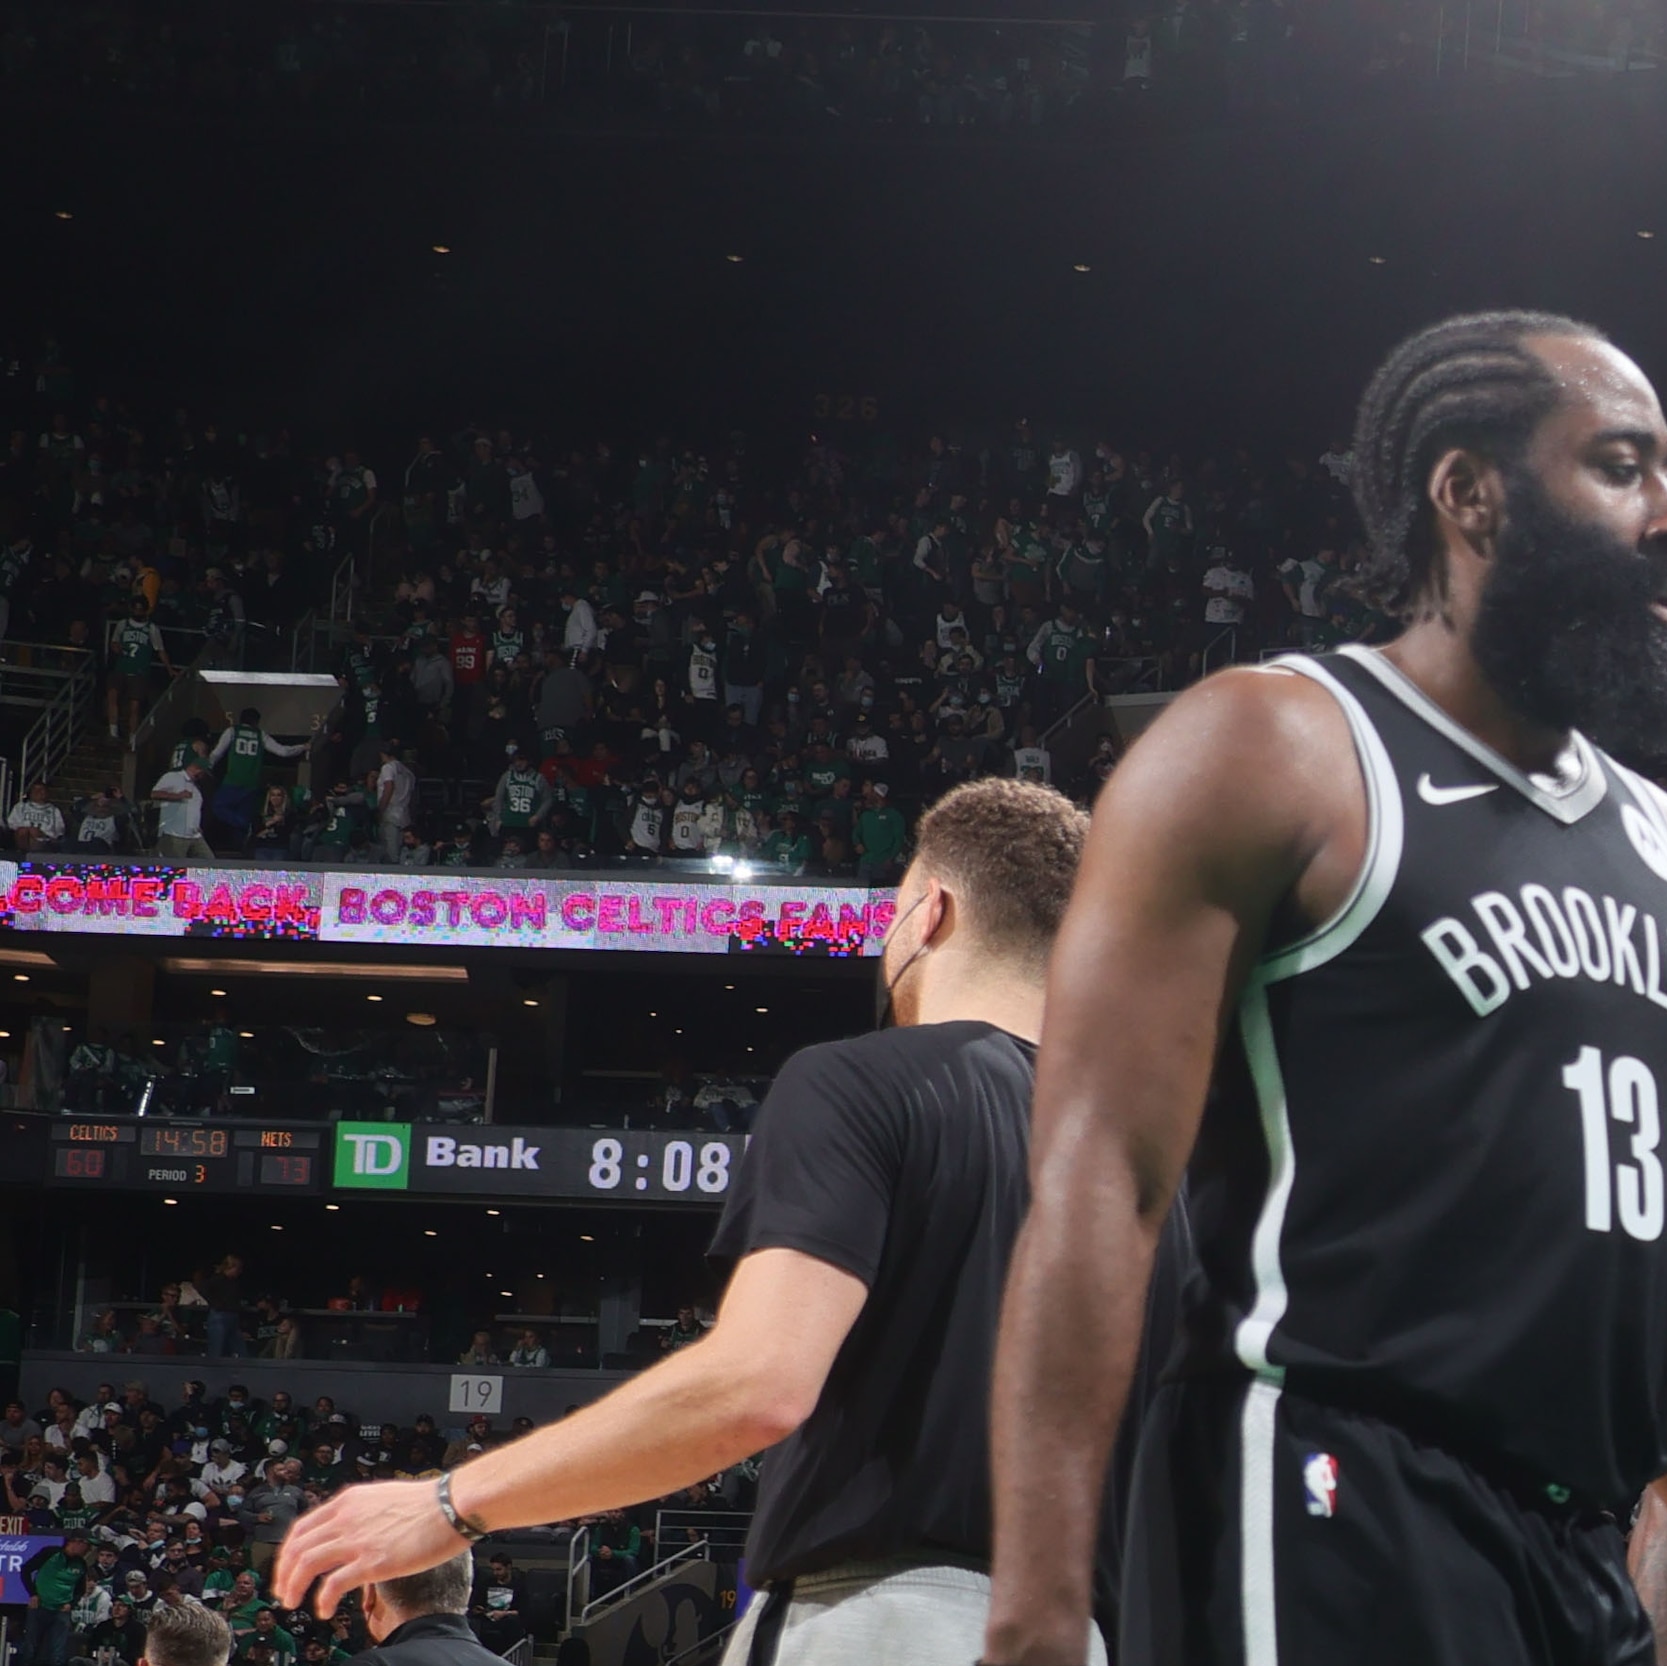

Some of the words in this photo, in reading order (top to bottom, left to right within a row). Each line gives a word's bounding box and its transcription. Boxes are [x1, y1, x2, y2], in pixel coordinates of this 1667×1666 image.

[236, 740, 257, 756] 00
[510, 797, 531, 812] 36
[0, 874, 164, 918] COME
[339, 888, 546, 929] BOSTON
[562, 893, 764, 940] CELTICS
[70, 1125, 118, 1141] CELTICS
[156, 1129, 226, 1157] 14:58
[260, 1131, 292, 1147] NETS
[1562, 1045, 1664, 1241] 13
[66, 1150, 103, 1176] 60
[343, 1134, 403, 1175] TD
[426, 1137, 540, 1169] Bank
[588, 1138, 731, 1193] 8:08
[149, 1168, 187, 1182] PERIOD
[195, 1164, 206, 1183] 3
[276, 1156, 308, 1182] 73
[461, 1380, 493, 1408] 19
[0, 1516, 25, 1535] EXIT
[719, 1590, 736, 1609] 19
